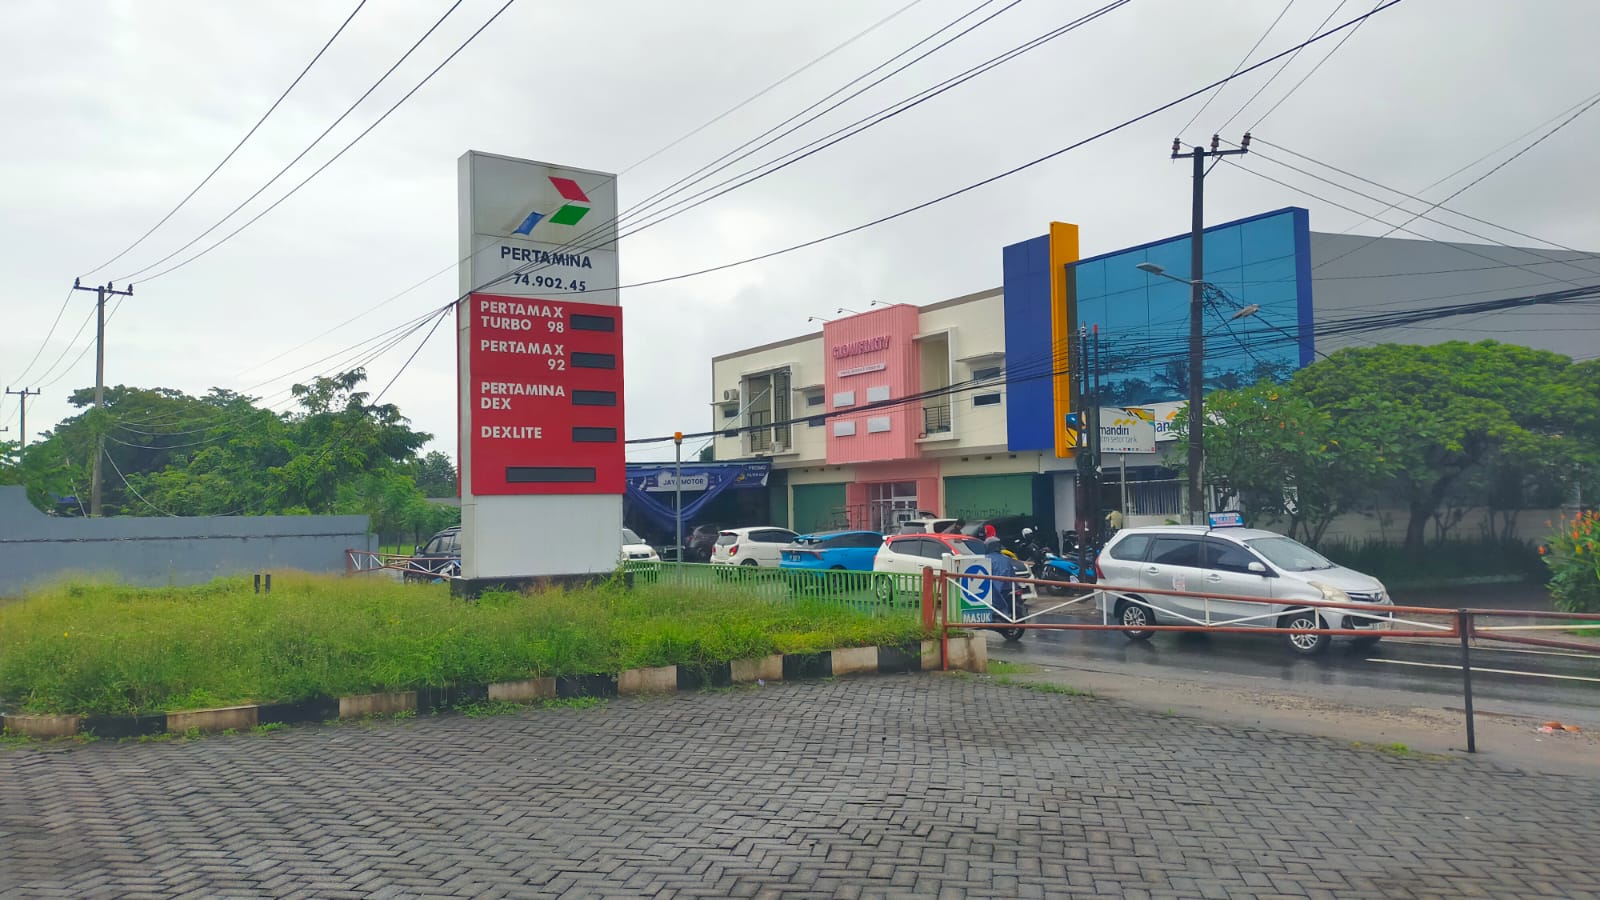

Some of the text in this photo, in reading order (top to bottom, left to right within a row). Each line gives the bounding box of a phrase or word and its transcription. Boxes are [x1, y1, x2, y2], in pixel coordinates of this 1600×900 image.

[501, 246, 592, 269] PERTAMINA
[514, 273, 586, 292] 74.902.45
[480, 301, 563, 318] PERTAMAX
[481, 316, 564, 334] TURBO 98
[481, 340, 564, 356] PERTAMAX
[548, 359, 565, 371] 92
[481, 382, 565, 397] PERTAMINA
[481, 397, 511, 410] DEX
[481, 426, 542, 439] DEXLITE
[963, 612, 991, 624] MASUK
